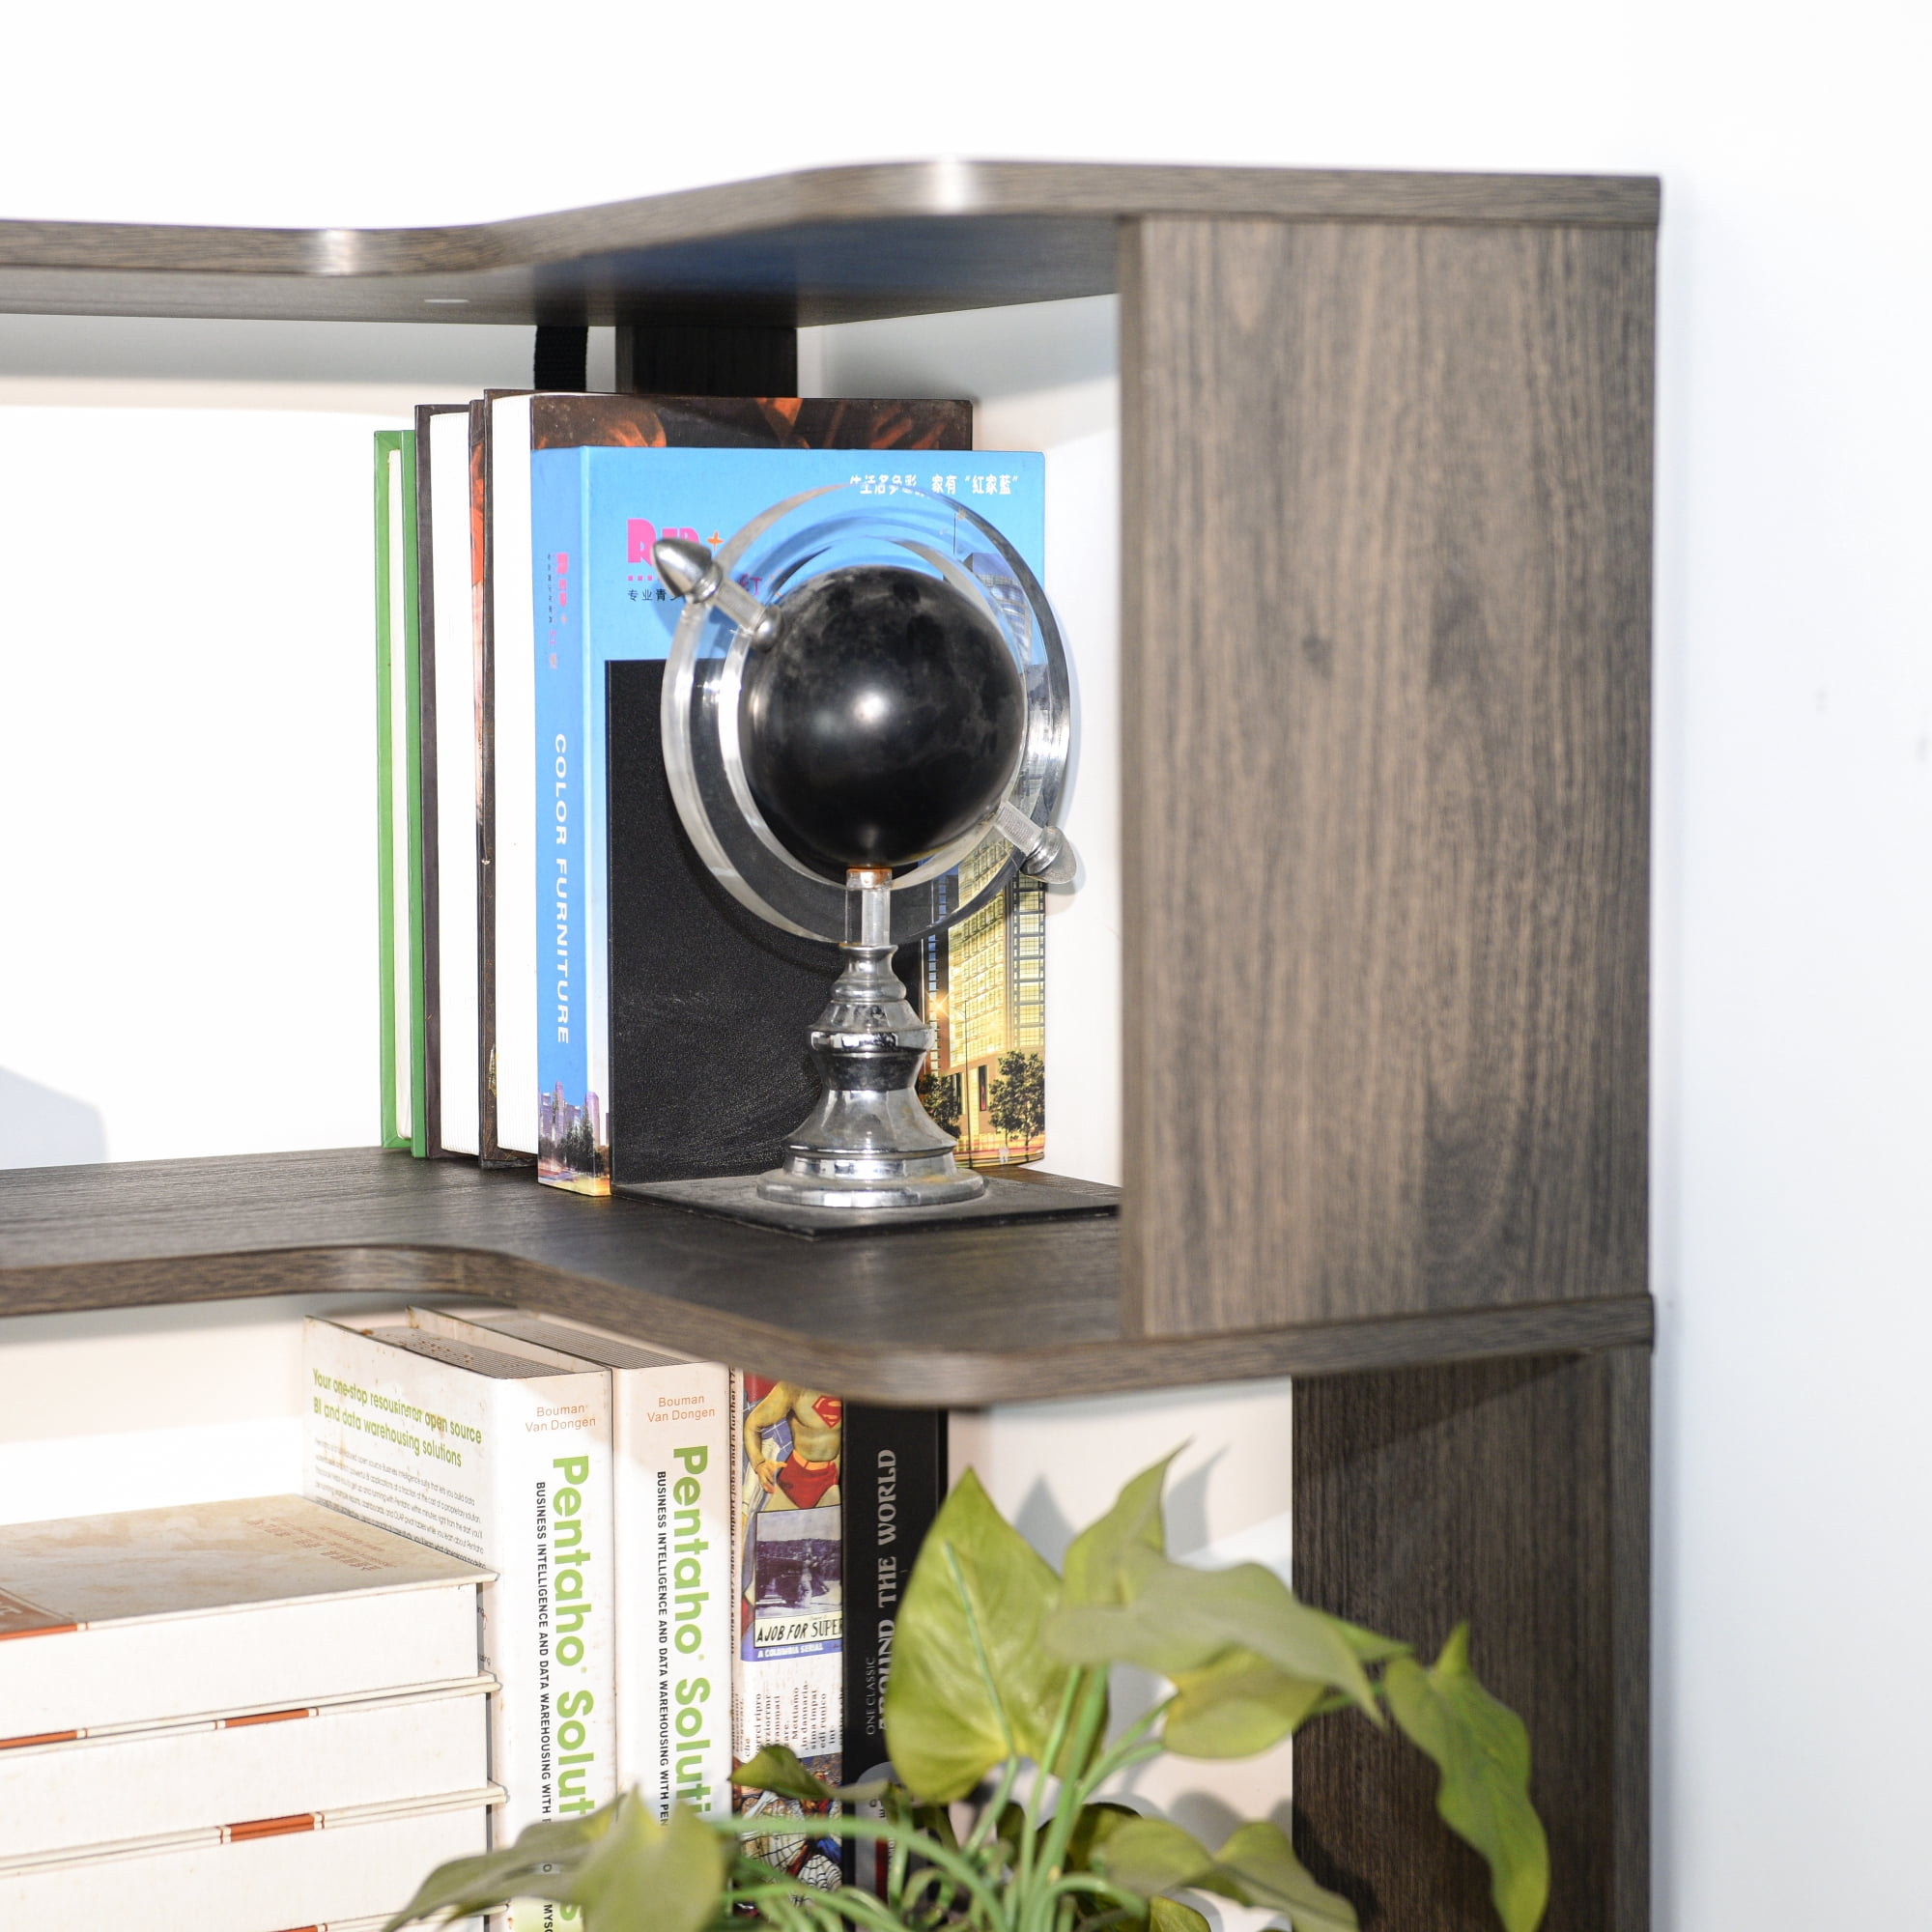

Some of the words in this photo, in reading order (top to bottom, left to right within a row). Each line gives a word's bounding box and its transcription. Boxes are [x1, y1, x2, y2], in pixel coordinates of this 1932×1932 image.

[554, 733, 568, 845] COLOR
[555, 858, 569, 1044] FURNITURE
[313, 1367, 331, 1390] Your
[333, 1379, 368, 1406] one-stop
[425, 1412, 448, 1432] open
[450, 1421, 482, 1444] source
[525, 1422, 548, 1433] Van
[551, 1417, 596, 1431] Dongen
[536, 1405, 585, 1417] Bouman
[647, 1412, 669, 1423] Van
[672, 1408, 716, 1421] Dongen
[658, 1395, 705, 1407] Bouman
[313, 1397, 322, 1415] BI
[324, 1404, 340, 1422] and
[342, 1407, 361, 1431] data
[364, 1419, 420, 1457] warehousing
[423, 1439, 462, 1468] solutions
[536, 1482, 547, 1540] BUSINESS
[657, 1471, 667, 1528] BUSINESS
[877, 1449, 896, 1545] WORLD
[553, 1455, 591, 1666] Pentaho
[658, 1532, 668, 1615] INTELLIGENCE
[673, 1445, 709, 1655] Pentaho
[538, 1544, 549, 1628] INTELLIGENCE
[878, 1557, 896, 1608] THE
[539, 1632, 550, 1656] AND
[658, 1620, 668, 1644] AND
[787, 1623, 809, 1640] FOR
[540, 1660, 550, 1690] DATA
[659, 1647, 668, 1677] DATA
[866, 1657, 876, 1706] CLASSIC
[540, 1692, 551, 1780] WAREHOUSING
[659, 1680, 668, 1767] WAREHOUSING
[675, 1677, 711, 1813] Soluti
[866, 1709, 876, 1735] ONE
[542, 1783, 552, 1814] WITH
[660, 1770, 669, 1801] WITH
